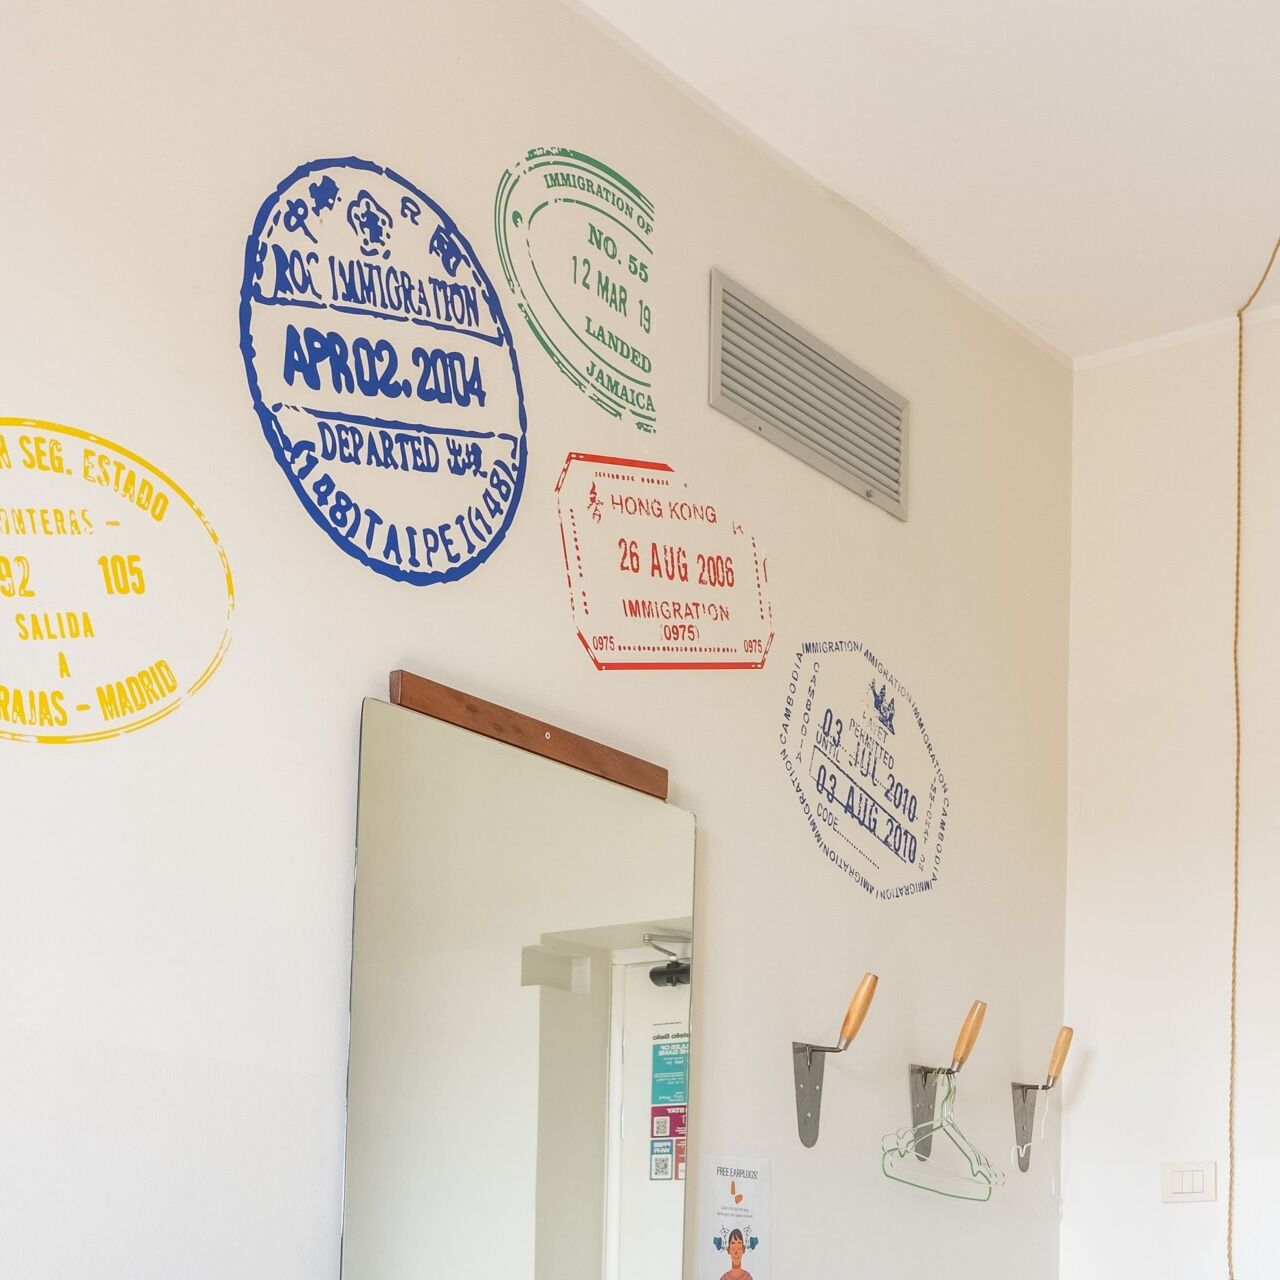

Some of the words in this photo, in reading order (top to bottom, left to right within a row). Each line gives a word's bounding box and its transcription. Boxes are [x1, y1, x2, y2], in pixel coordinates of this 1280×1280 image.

[543, 172, 634, 219] IMMIGRATION
[637, 214, 654, 236] OF
[587, 222, 622, 265] NO.
[628, 253, 649, 283] 55
[328, 255, 480, 328] IMMIGRATION
[572, 255, 591, 290] 12
[597, 270, 628, 317] MAR
[638, 299, 652, 334] 19
[585, 316, 652, 374] LANDED
[586, 361, 656, 412] JAMAICA
[317, 422, 439, 473] DEPARTED
[20, 436, 73, 475] SEG.
[83, 449, 170, 522] ESTADO
[610, 494, 663, 519] HONG
[669, 501, 717, 524] KONG
[97, 555, 146, 596] 105
[618, 538, 640, 574] 26
[650, 542, 689, 583] AUG
[696, 553, 735, 588] 2006
[15, 612, 95, 641] SALIDA
[622, 599, 730, 621] IMMIGRATION
[58, 652, 71, 679] A
[592, 635, 615, 652] 0975
[743, 639, 763, 654] 0975
[95, 659, 178, 722] MADRID
[779, 651, 803, 745] CAMBODIA
[815, 731, 841, 764] UNTIL
[822, 708, 843, 748] 03
[884, 773, 918, 823] 2010
[816, 764, 837, 803] 03
[844, 785, 878, 834] AUG
[883, 818, 917, 864] 2010
[931, 797, 950, 882] CAMBODIA
[716, 1166, 729, 1177] FREE
